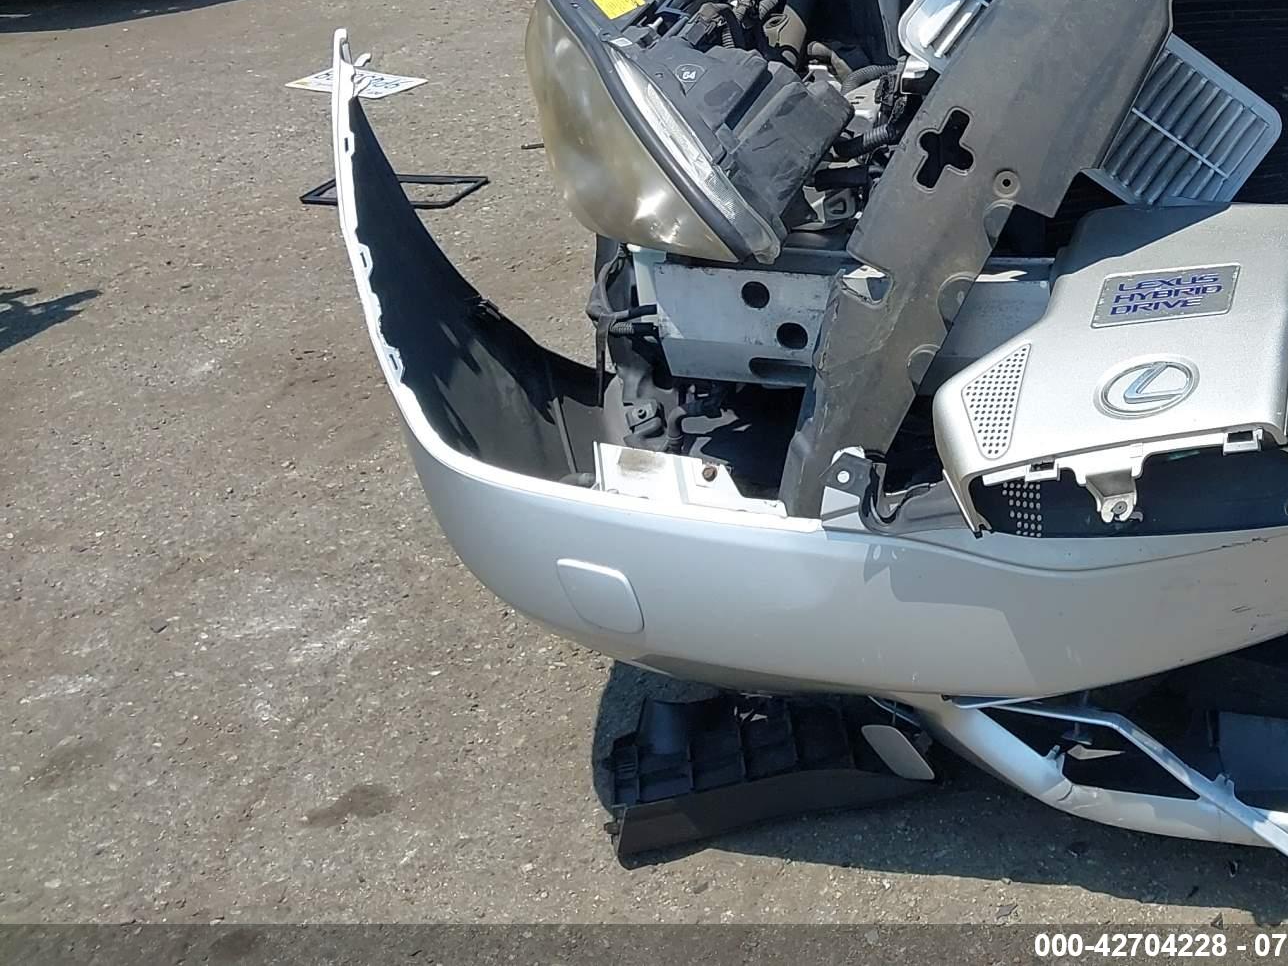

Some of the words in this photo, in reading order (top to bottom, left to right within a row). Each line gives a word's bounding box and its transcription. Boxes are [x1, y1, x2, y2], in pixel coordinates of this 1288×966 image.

[1118, 273, 1220, 292] LEXUS
[1114, 285, 1222, 303] HYBRID
[1110, 296, 1203, 315] DRIVE
